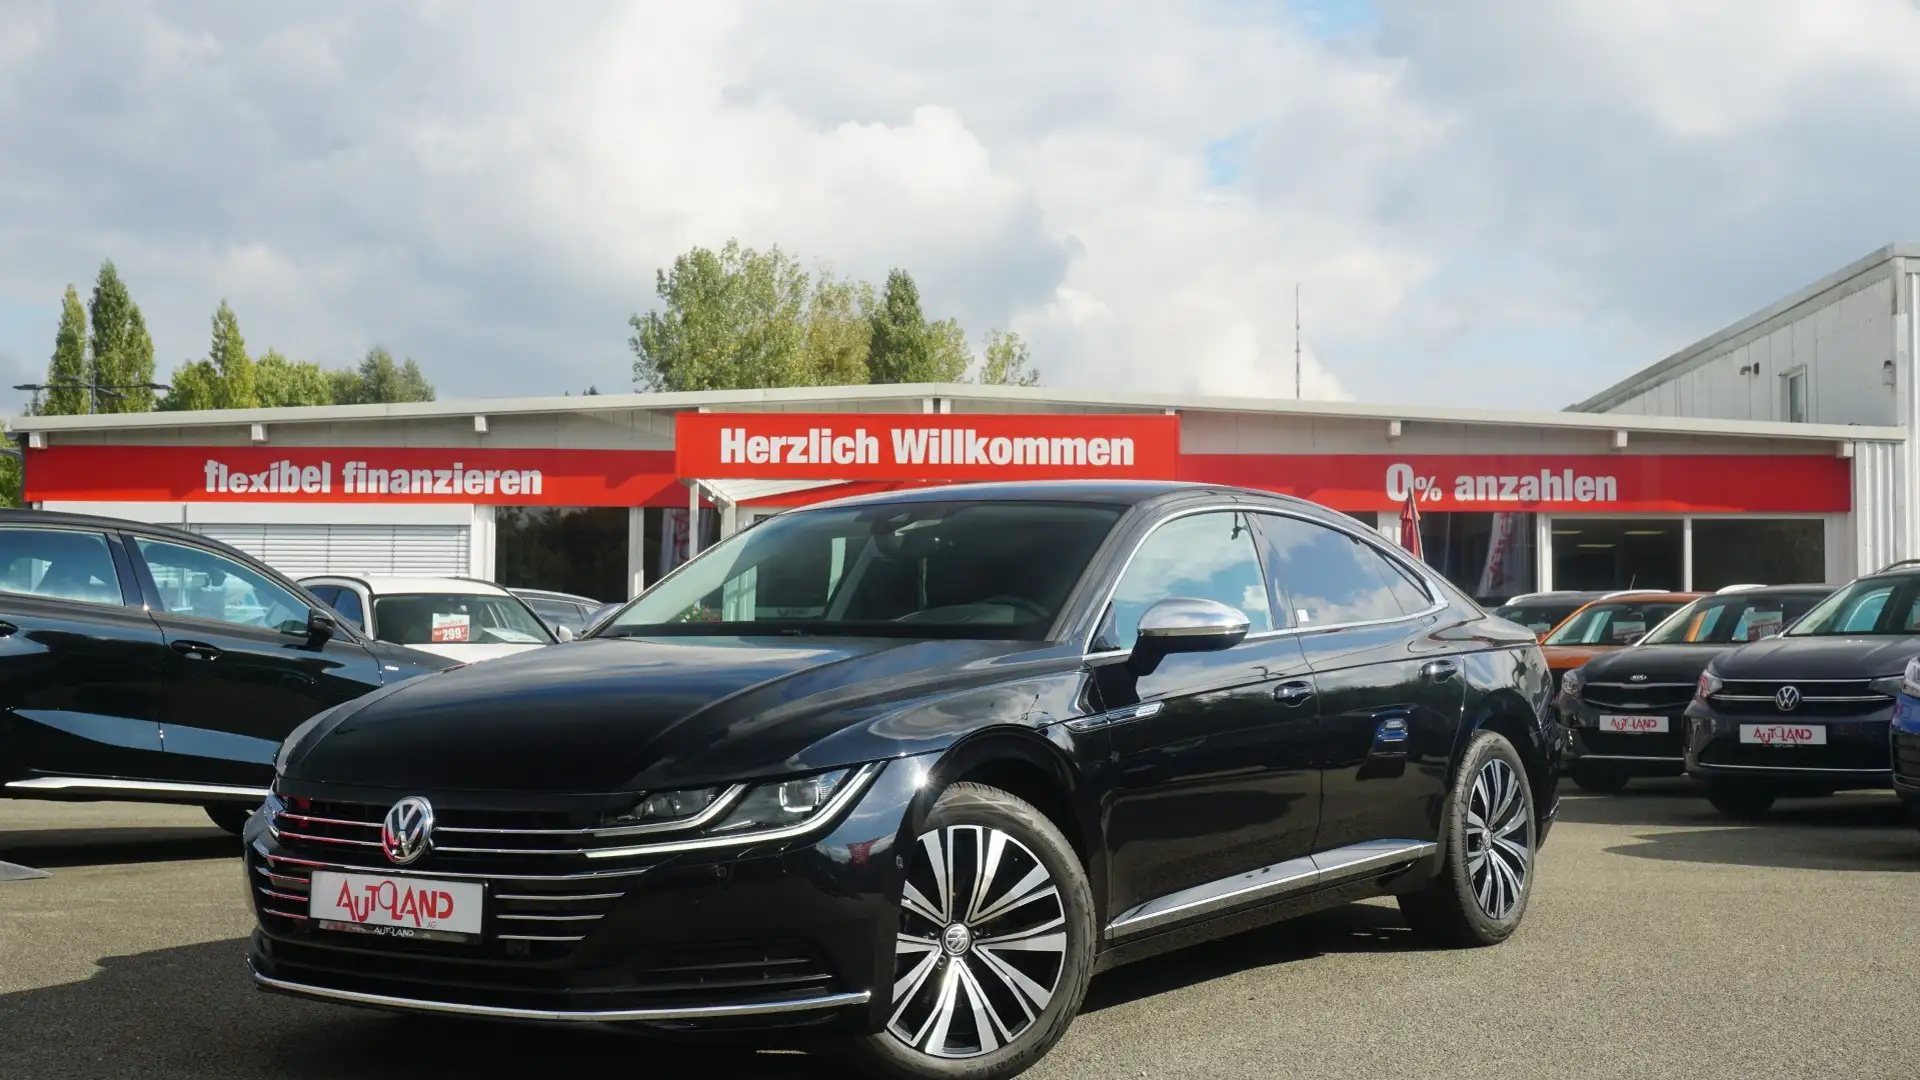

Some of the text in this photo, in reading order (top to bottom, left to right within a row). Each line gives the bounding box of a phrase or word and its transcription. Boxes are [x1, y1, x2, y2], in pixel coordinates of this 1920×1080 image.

[720, 428, 1135, 466] Herzlich Willkommen
[204, 459, 543, 495] flexibel finanzieren
[1386, 463, 1617, 503] 0% anzahlen
[1753, 725, 1813, 744] AUTOLAND
[336, 877, 454, 927] AUTOLAND
[373, 926, 415, 938] AUTOLAND
[427, 921, 437, 929] AG
